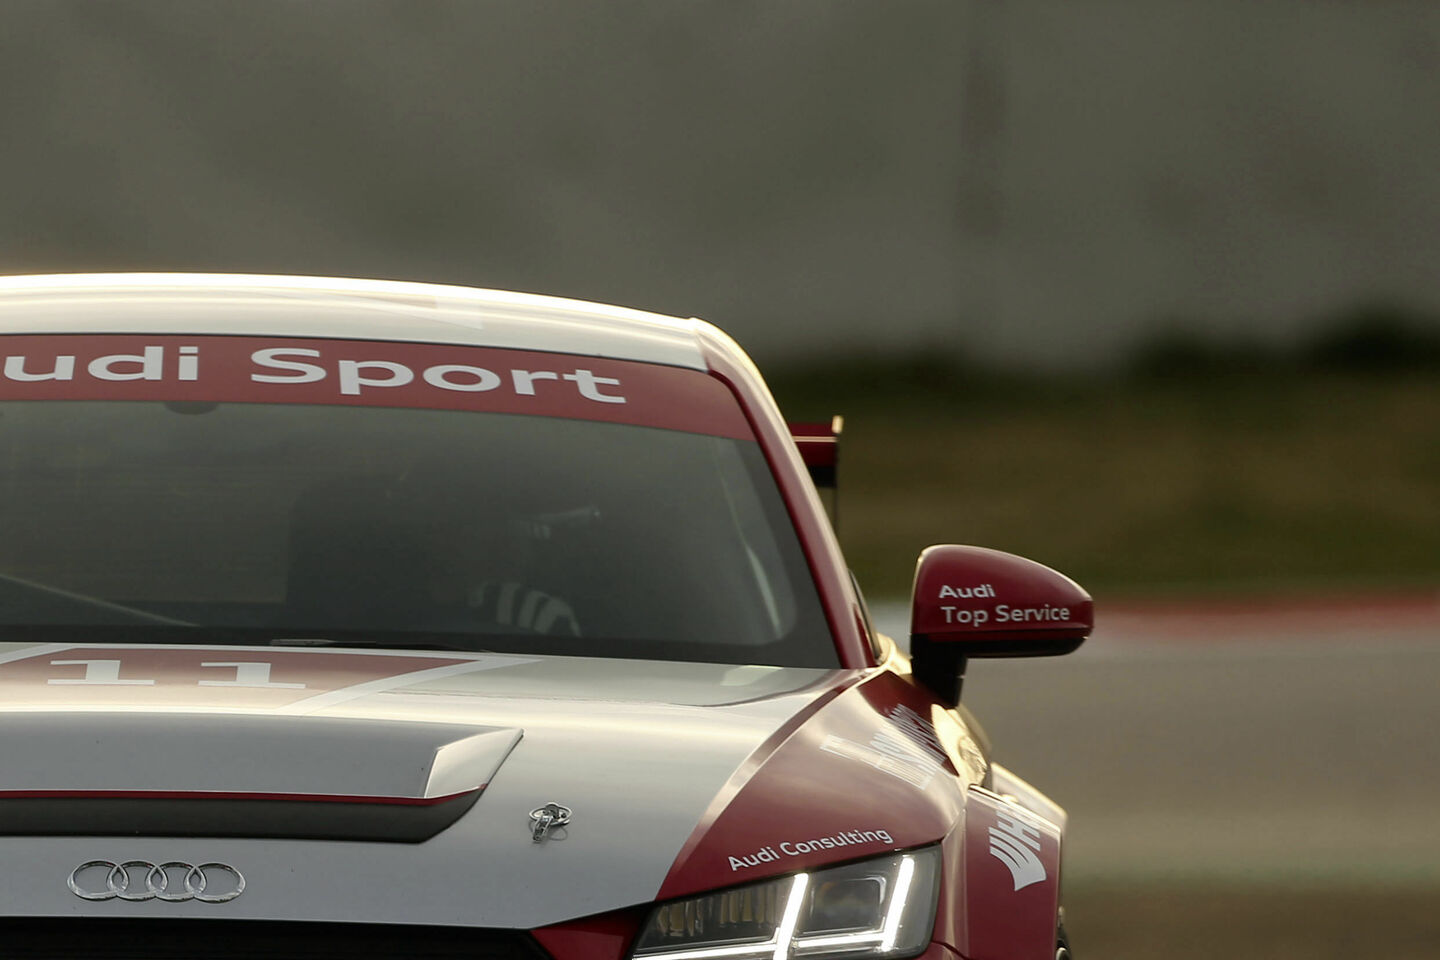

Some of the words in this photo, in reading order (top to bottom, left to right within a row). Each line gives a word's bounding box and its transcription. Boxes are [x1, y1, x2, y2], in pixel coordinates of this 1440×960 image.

[250, 347, 627, 404] Sport
[939, 584, 996, 599] Audi
[940, 606, 989, 628] Top
[995, 604, 1071, 623] Service
[47, 659, 306, 689] 11
[728, 846, 780, 871] Audi
[780, 829, 894, 856] Consulting
